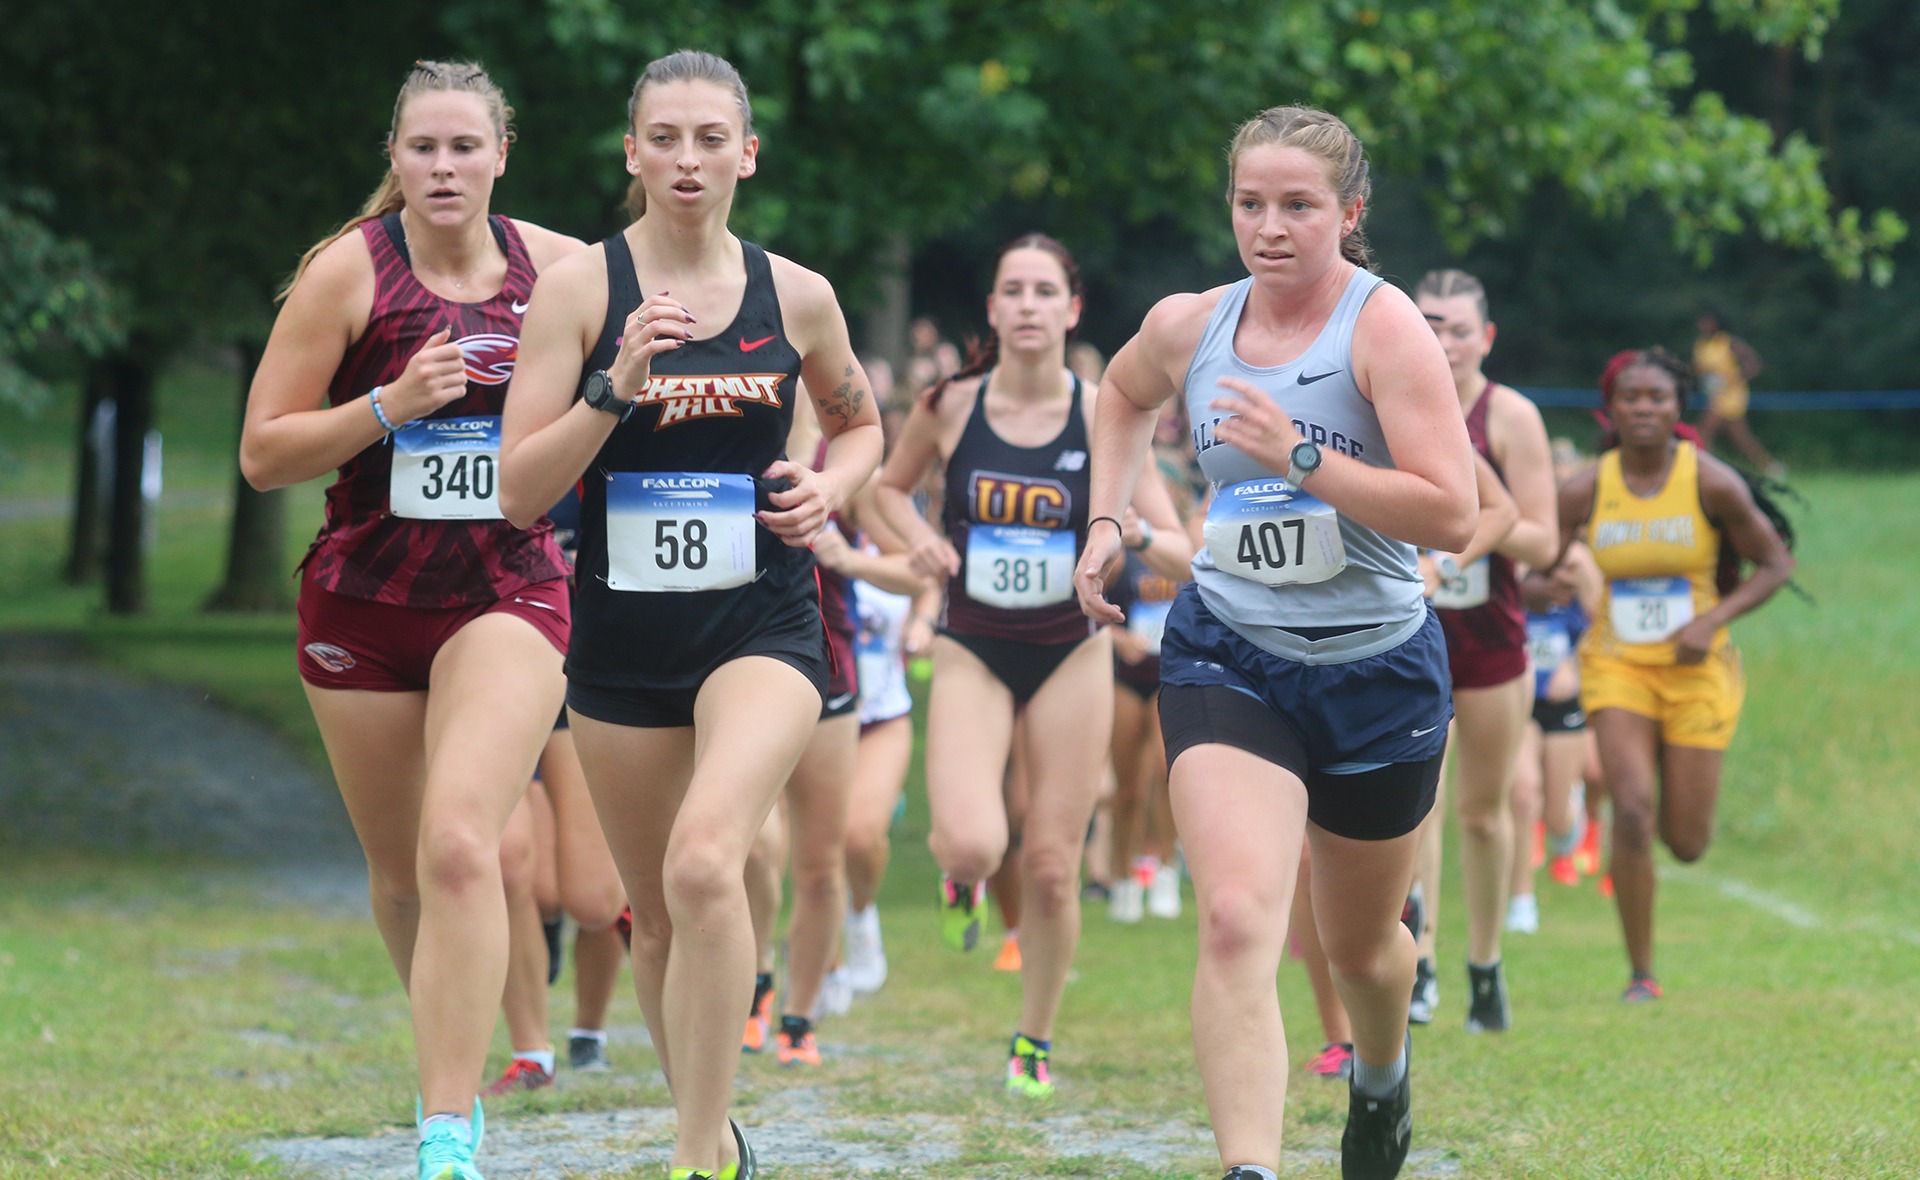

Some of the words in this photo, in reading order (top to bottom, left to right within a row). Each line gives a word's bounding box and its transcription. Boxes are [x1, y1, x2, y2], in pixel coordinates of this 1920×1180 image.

[427, 420, 494, 431] FALCON
[659, 398, 739, 427] HILL
[422, 455, 494, 500] 340
[642, 478, 720, 489] FALCON
[1234, 482, 1289, 496] FALCO
[971, 474, 1068, 528] UC
[655, 519, 708, 570] 58
[1237, 519, 1305, 570] 407
[993, 558, 1047, 593] 381
[1638, 600, 1668, 631] 20
